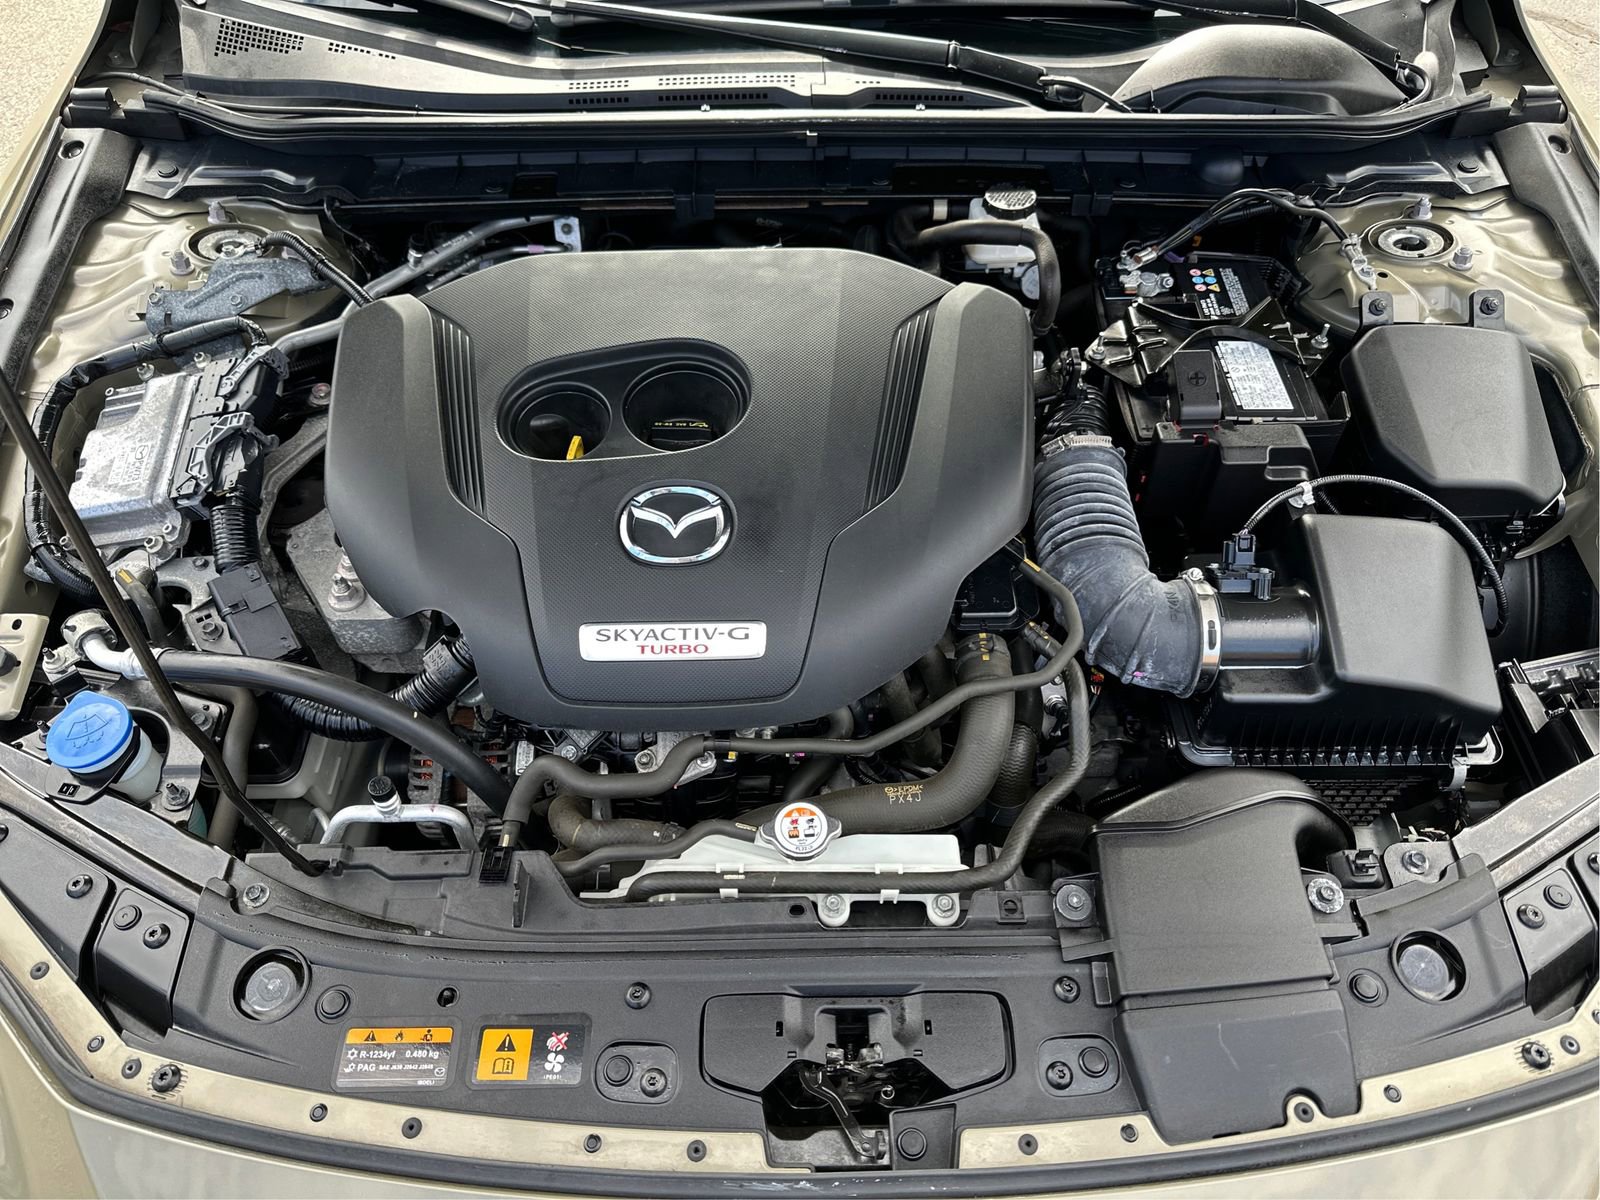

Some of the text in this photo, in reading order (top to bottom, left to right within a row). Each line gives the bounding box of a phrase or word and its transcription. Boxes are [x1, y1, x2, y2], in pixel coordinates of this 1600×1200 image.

[595, 627, 750, 642] SKYACTIV-G
[636, 643, 709, 655] TURBO
[359, 1049, 440, 1060] R-1234yf 0.480 kg
[357, 1063, 376, 1072] PAG
